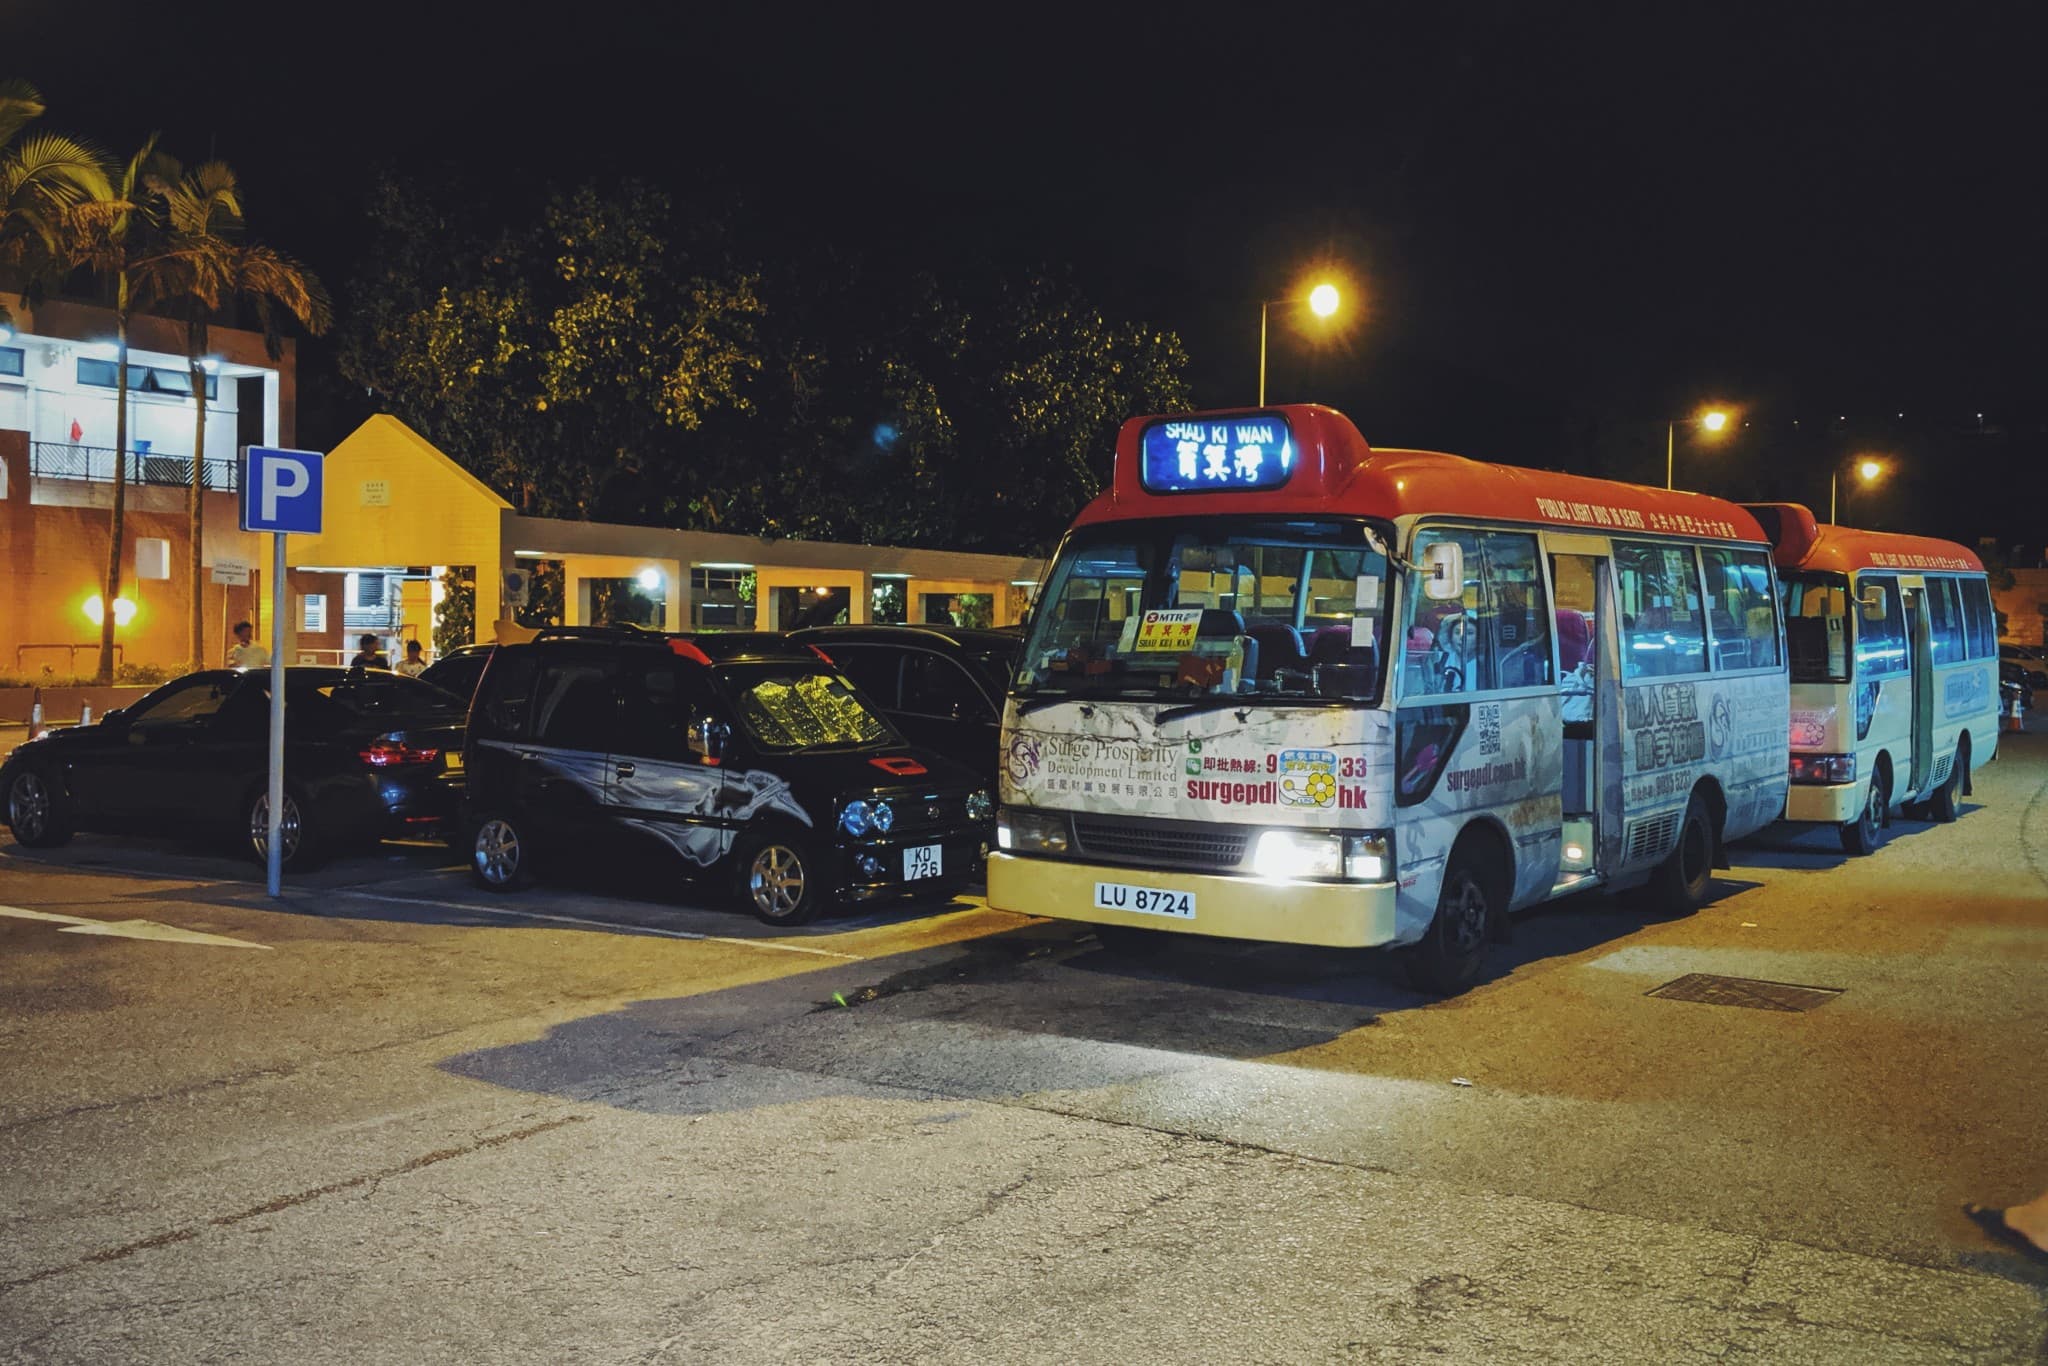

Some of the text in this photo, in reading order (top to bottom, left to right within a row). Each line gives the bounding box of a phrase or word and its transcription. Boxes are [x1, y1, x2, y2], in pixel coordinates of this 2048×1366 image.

[1165, 423, 1274, 444] SHAU KI WAN
[262, 456, 310, 521] P
[1535, 497, 1571, 521] PUBLIC
[1568, 501, 1594, 522] LIGHT
[1618, 508, 1646, 530] SEATS
[1159, 613, 1184, 622] MTR
[1049, 736, 1178, 768] Surge Prosperity
[1048, 760, 1178, 783] Development Limited
[1338, 757, 1368, 778] 33
[915, 847, 931, 863] KD
[911, 861, 938, 880] 726
[1101, 885, 1189, 915] LU 8724
